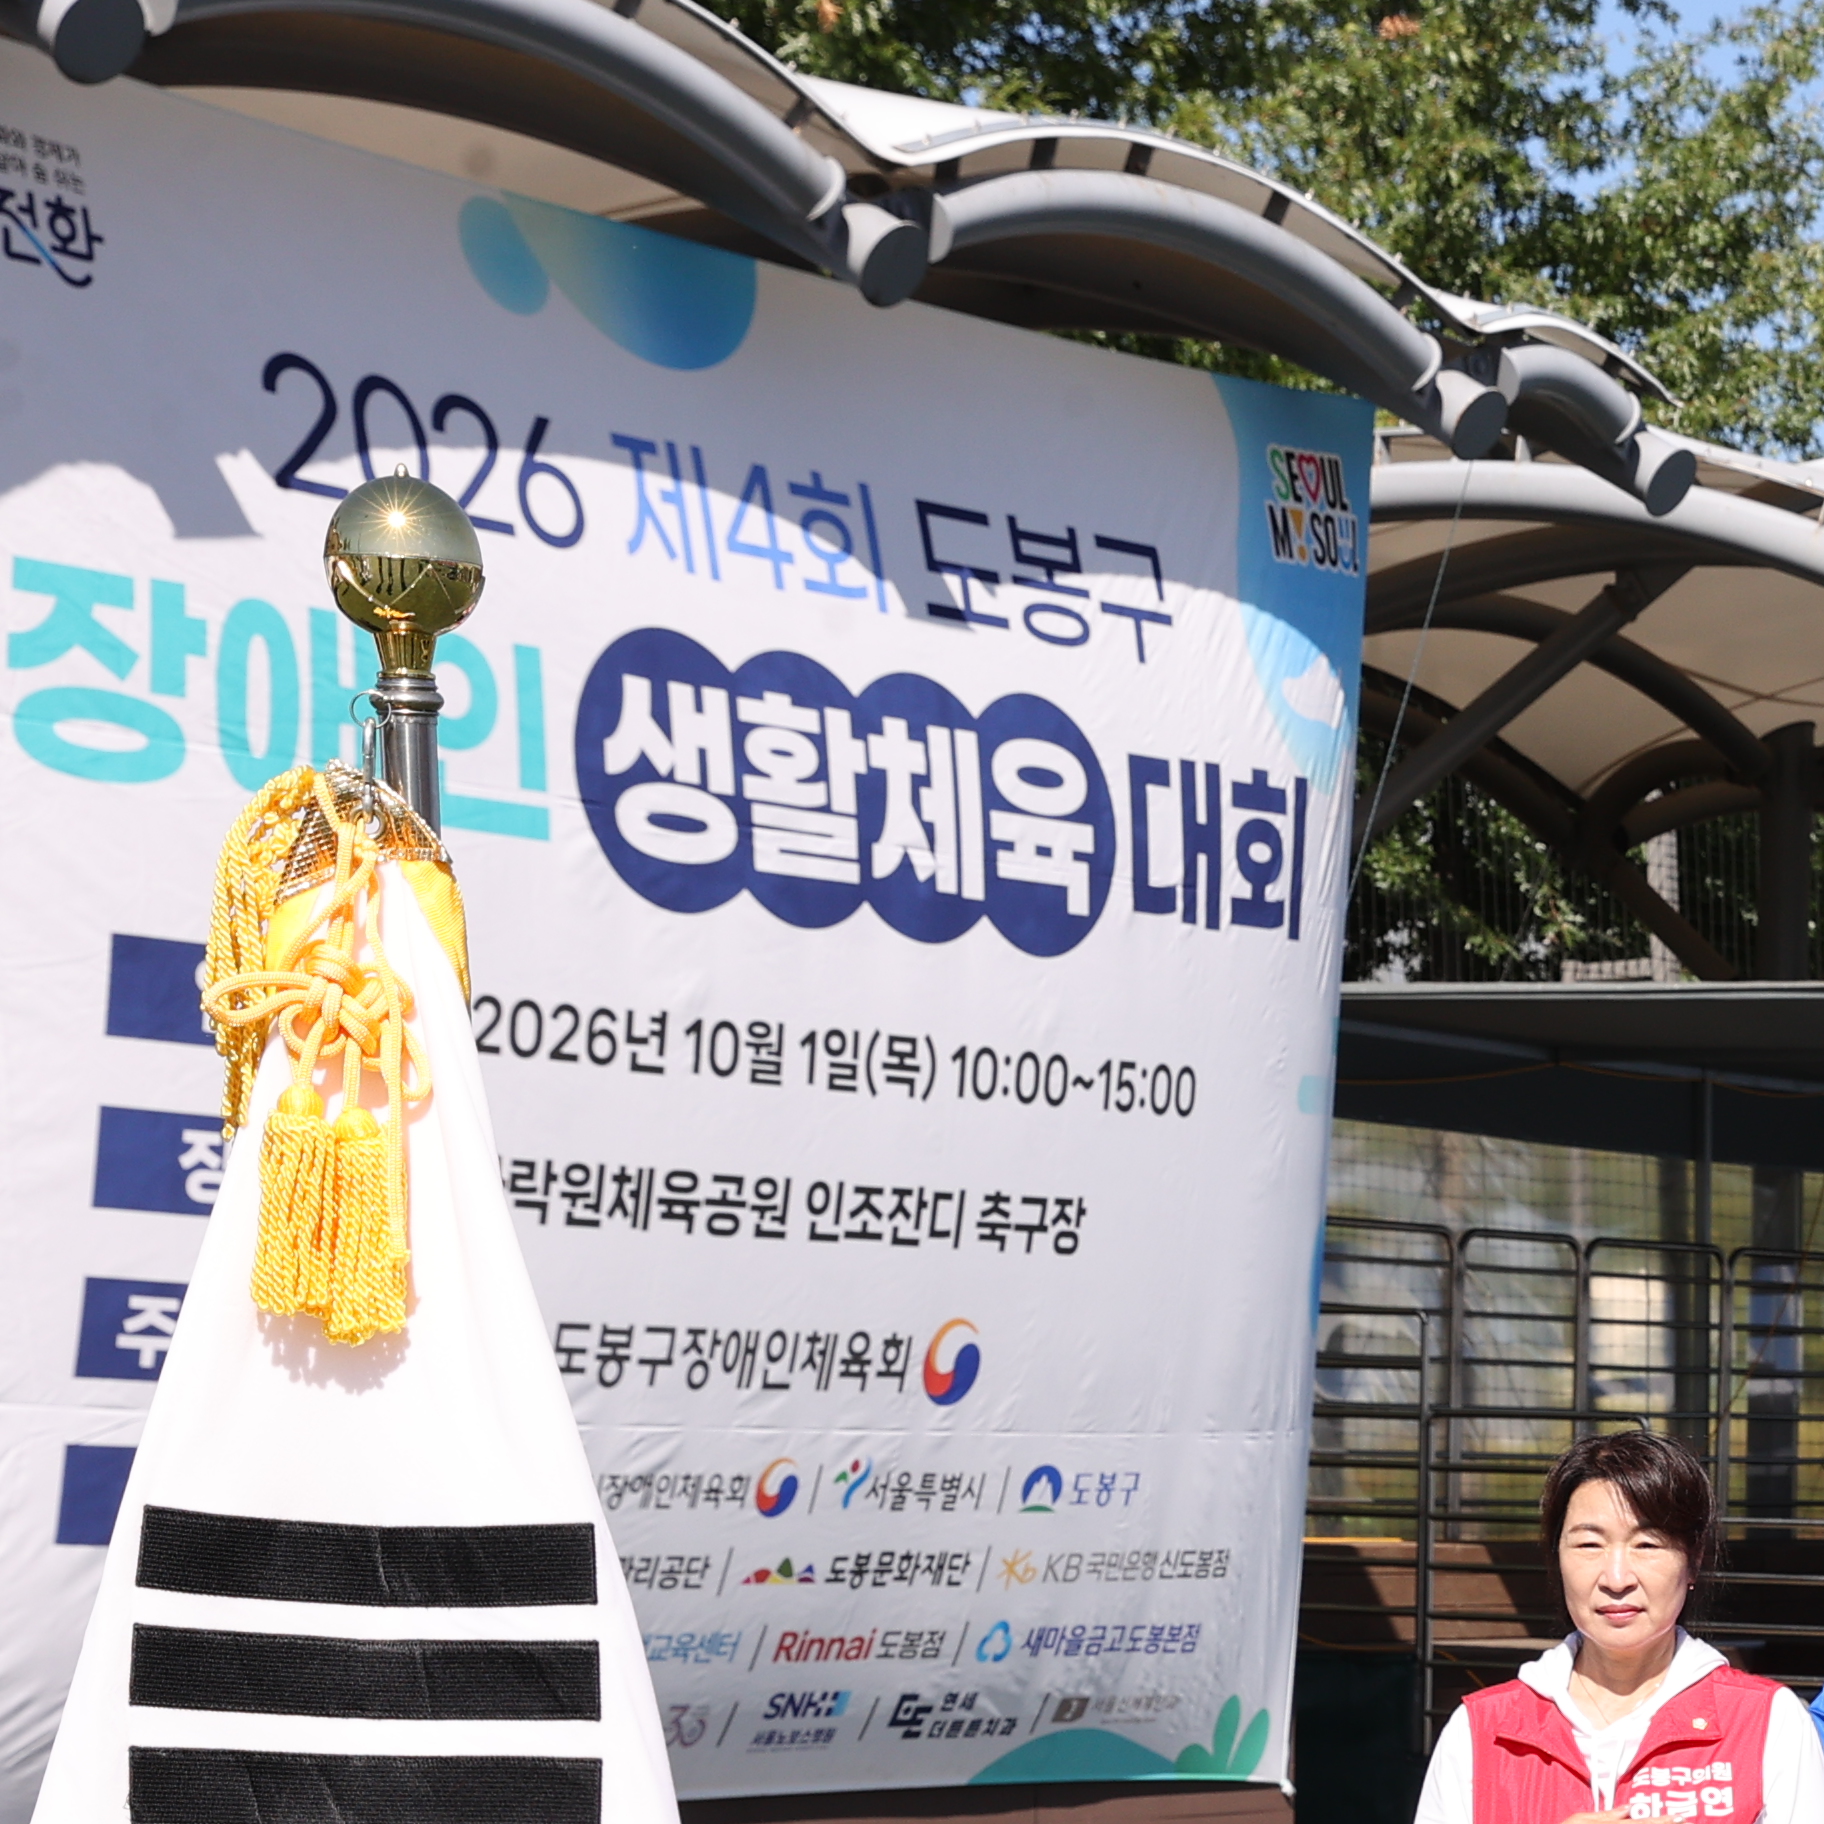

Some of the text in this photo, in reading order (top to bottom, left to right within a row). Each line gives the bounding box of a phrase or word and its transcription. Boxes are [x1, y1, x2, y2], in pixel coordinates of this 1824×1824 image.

[262, 351, 1174, 665] 2026 제4회 도봉구
[7, 555, 1308, 942] 장애인 생활체육 대회
[472, 995, 1198, 1119] 2026년 10월 1일(목) 10:00~15:00
[498, 1157, 1088, 1256] 락원체육공원 인조잔디 축구장
[553, 1319, 914, 1394] 도봉구장애인체육회
[864, 1470, 987, 1513] 서울특별시
[1068, 1471, 1142, 1508] 도봉구
[823, 1549, 972, 1590] 도봉문화재단
[643, 1630, 743, 1665] 교육센터
[771, 1627, 947, 1663] Rinnai 도봉점
[1020, 1622, 1203, 1658] 새마을금고도봉본점
[1631, 1761, 1733, 1789] 도봉구의원
